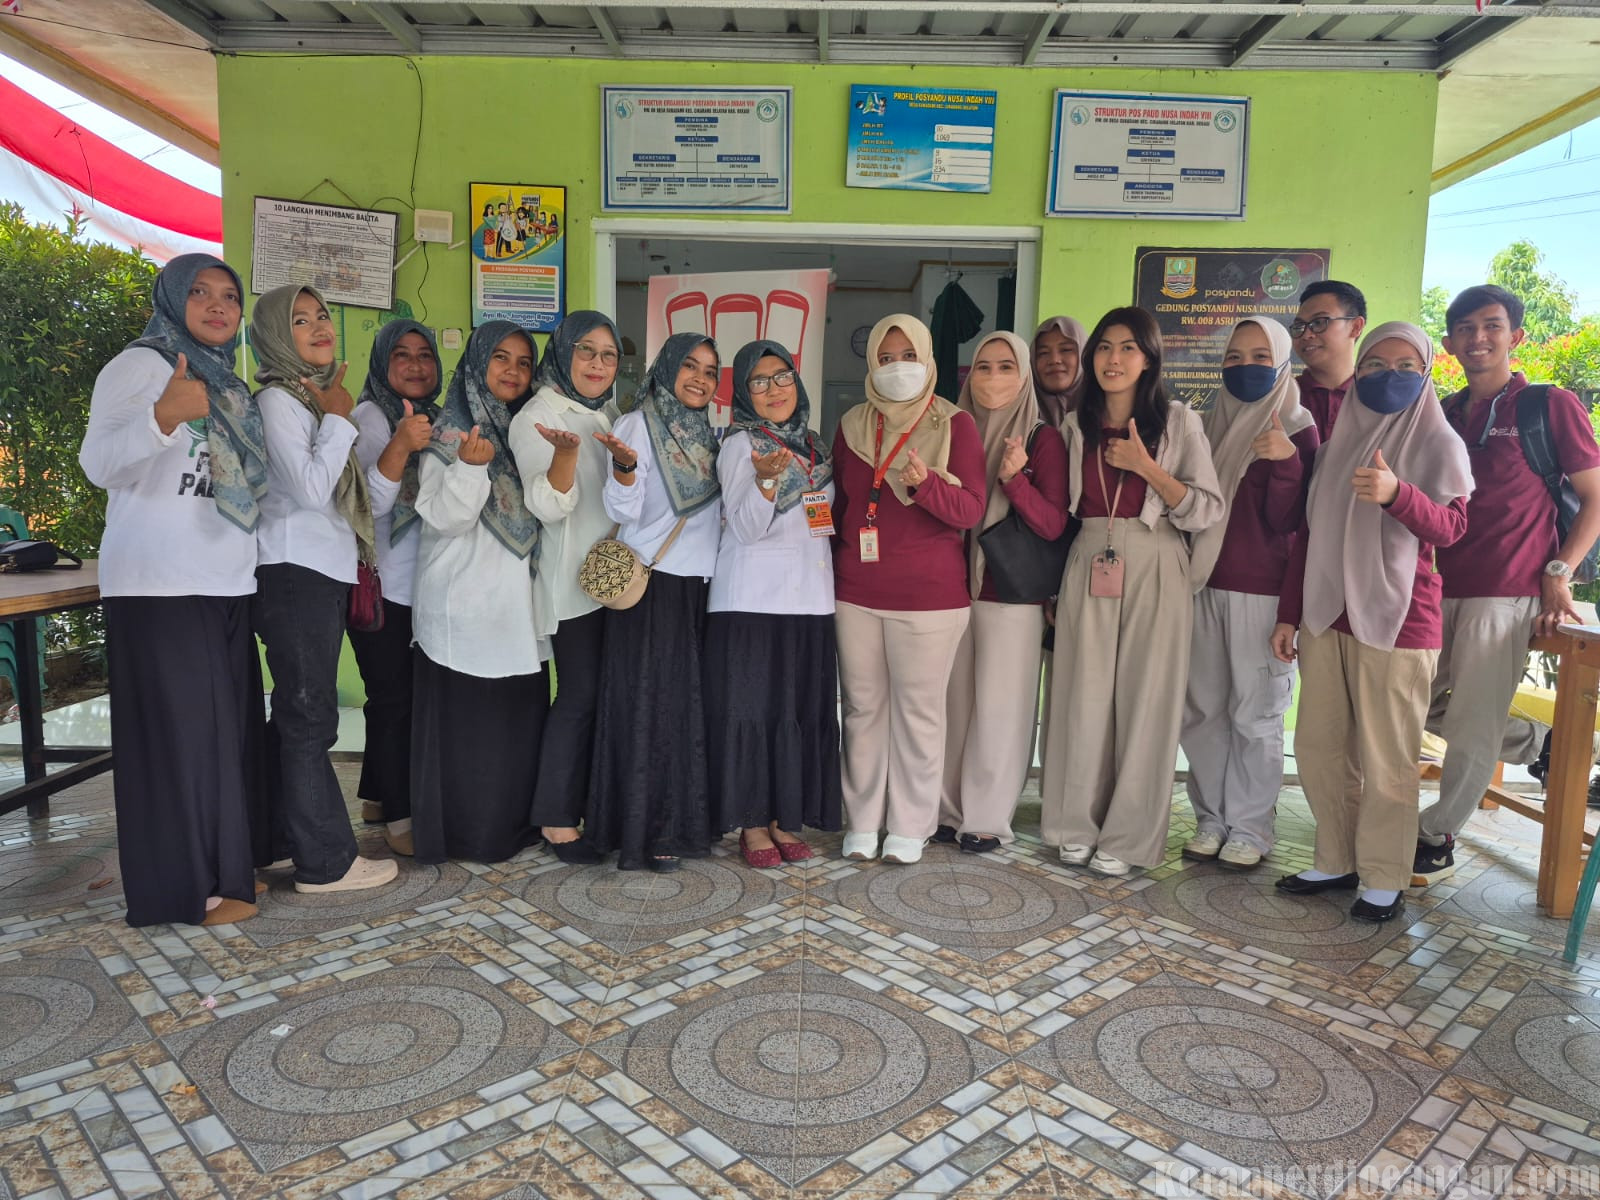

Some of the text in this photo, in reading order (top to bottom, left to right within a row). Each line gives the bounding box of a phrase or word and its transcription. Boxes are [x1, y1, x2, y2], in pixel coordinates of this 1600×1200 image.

[894, 92, 914, 100] PROFIL
[916, 93, 946, 102] POSYANDU
[966, 96, 983, 104] INDAH
[1094, 108, 1212, 120] STRUKTUR POS PAUD NUSA INDAH VIII
[284, 206, 314, 215] LANGKAH
[315, 208, 355, 220] MENIMBANG
[356, 214, 379, 222] BALITA
[1204, 288, 1256, 298] posyandu
[1156, 304, 1190, 312] GEDUNG
[1191, 304, 1234, 313] POSYANDU
[1236, 304, 1257, 313] NUSA
[1259, 304, 1286, 314] INDAH
[1181, 317, 1196, 325] RW.
[1198, 317, 1213, 325] 008
[1215, 317, 1233, 325] ASRI
